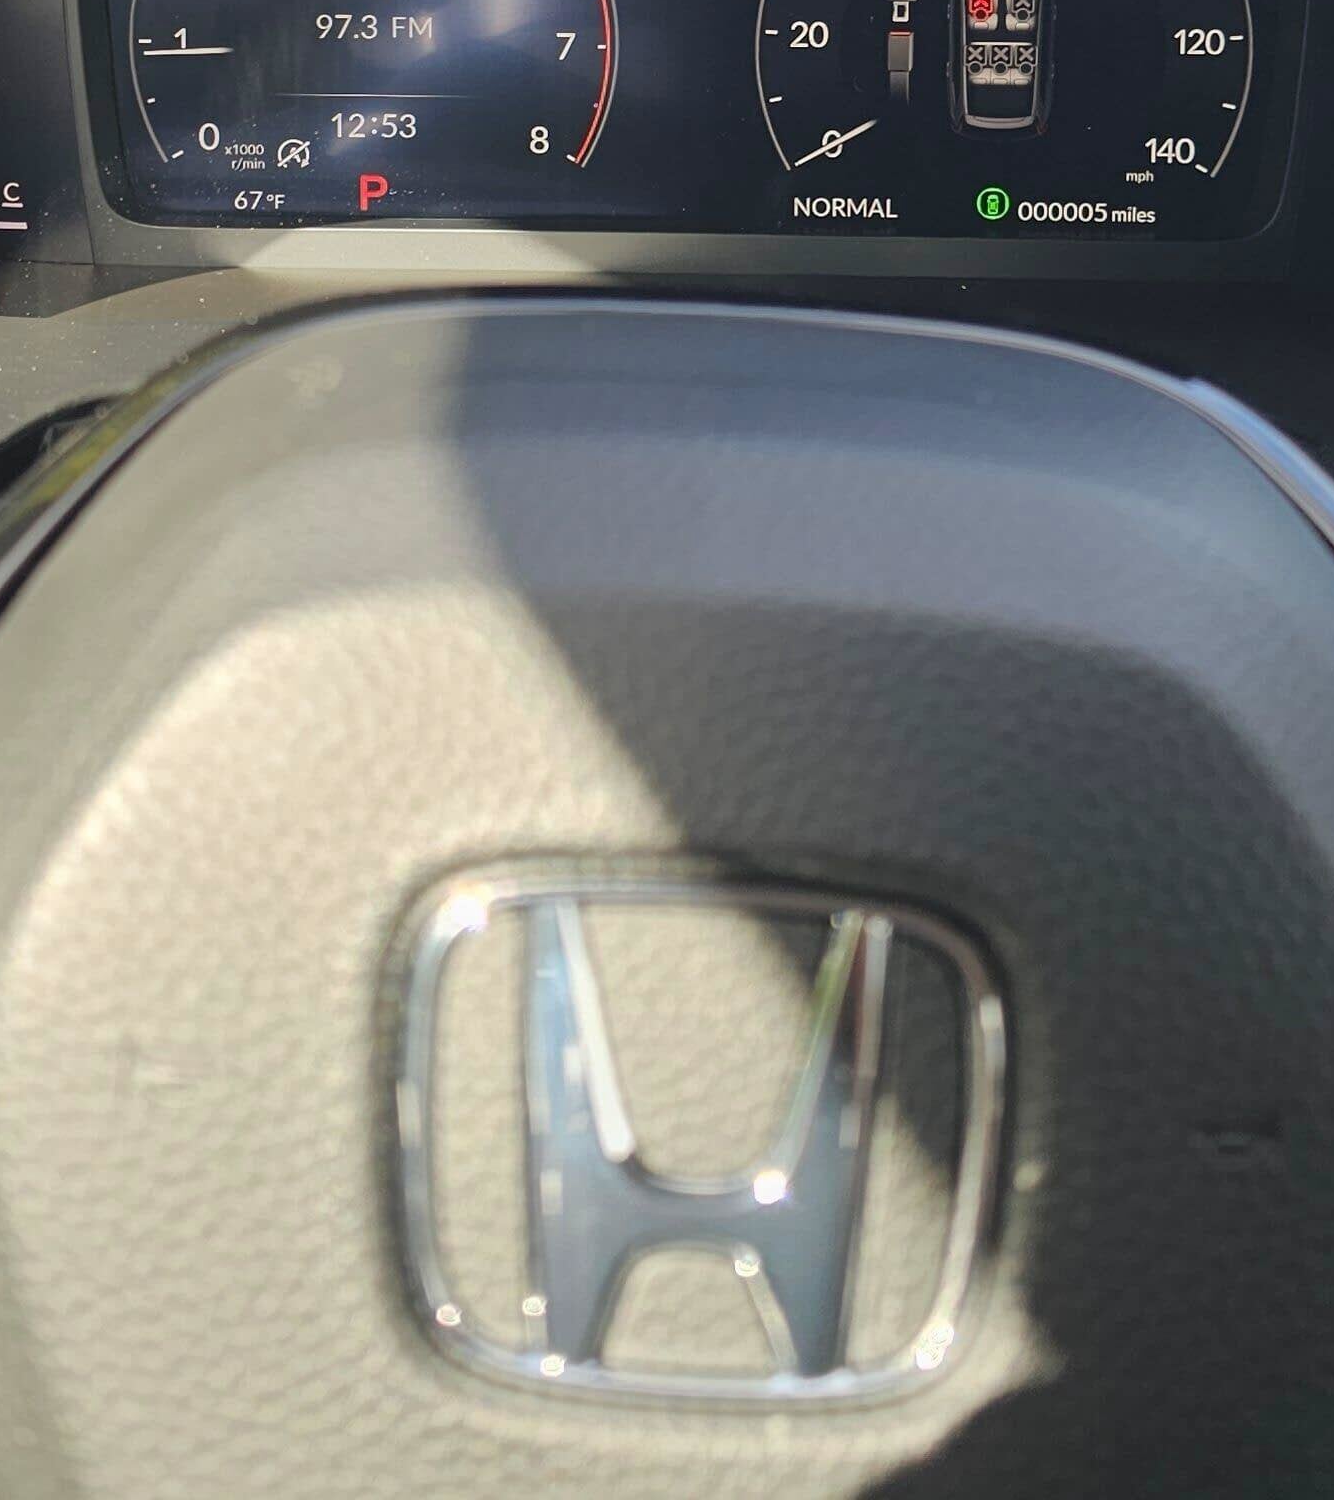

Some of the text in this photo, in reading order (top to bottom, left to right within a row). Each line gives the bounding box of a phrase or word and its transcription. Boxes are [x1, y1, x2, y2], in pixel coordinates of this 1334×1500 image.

[175, 28, 187, 48] 1
[316, 15, 433, 40] 97.3 FM
[790, 22, 829, 48] 20
[556, 33, 576, 60] 7
[1174, 29, 1225, 56] 120
[198, 123, 220, 151] 0
[332, 113, 417, 139] 12:53
[225, 144, 265, 156] x1000
[530, 126, 550, 153] 8
[822, 130, 843, 158] 0
[1145, 138, 1195, 164] 140
[231, 158, 265, 171] r/min
[1126, 171, 1154, 183] mph
[3, 182, 20, 202] C
[234, 191, 263, 210] 67
[359, 174, 388, 211] P
[793, 197, 898, 219] NORMAL
[1018, 201, 1156, 223] 000005 miles
